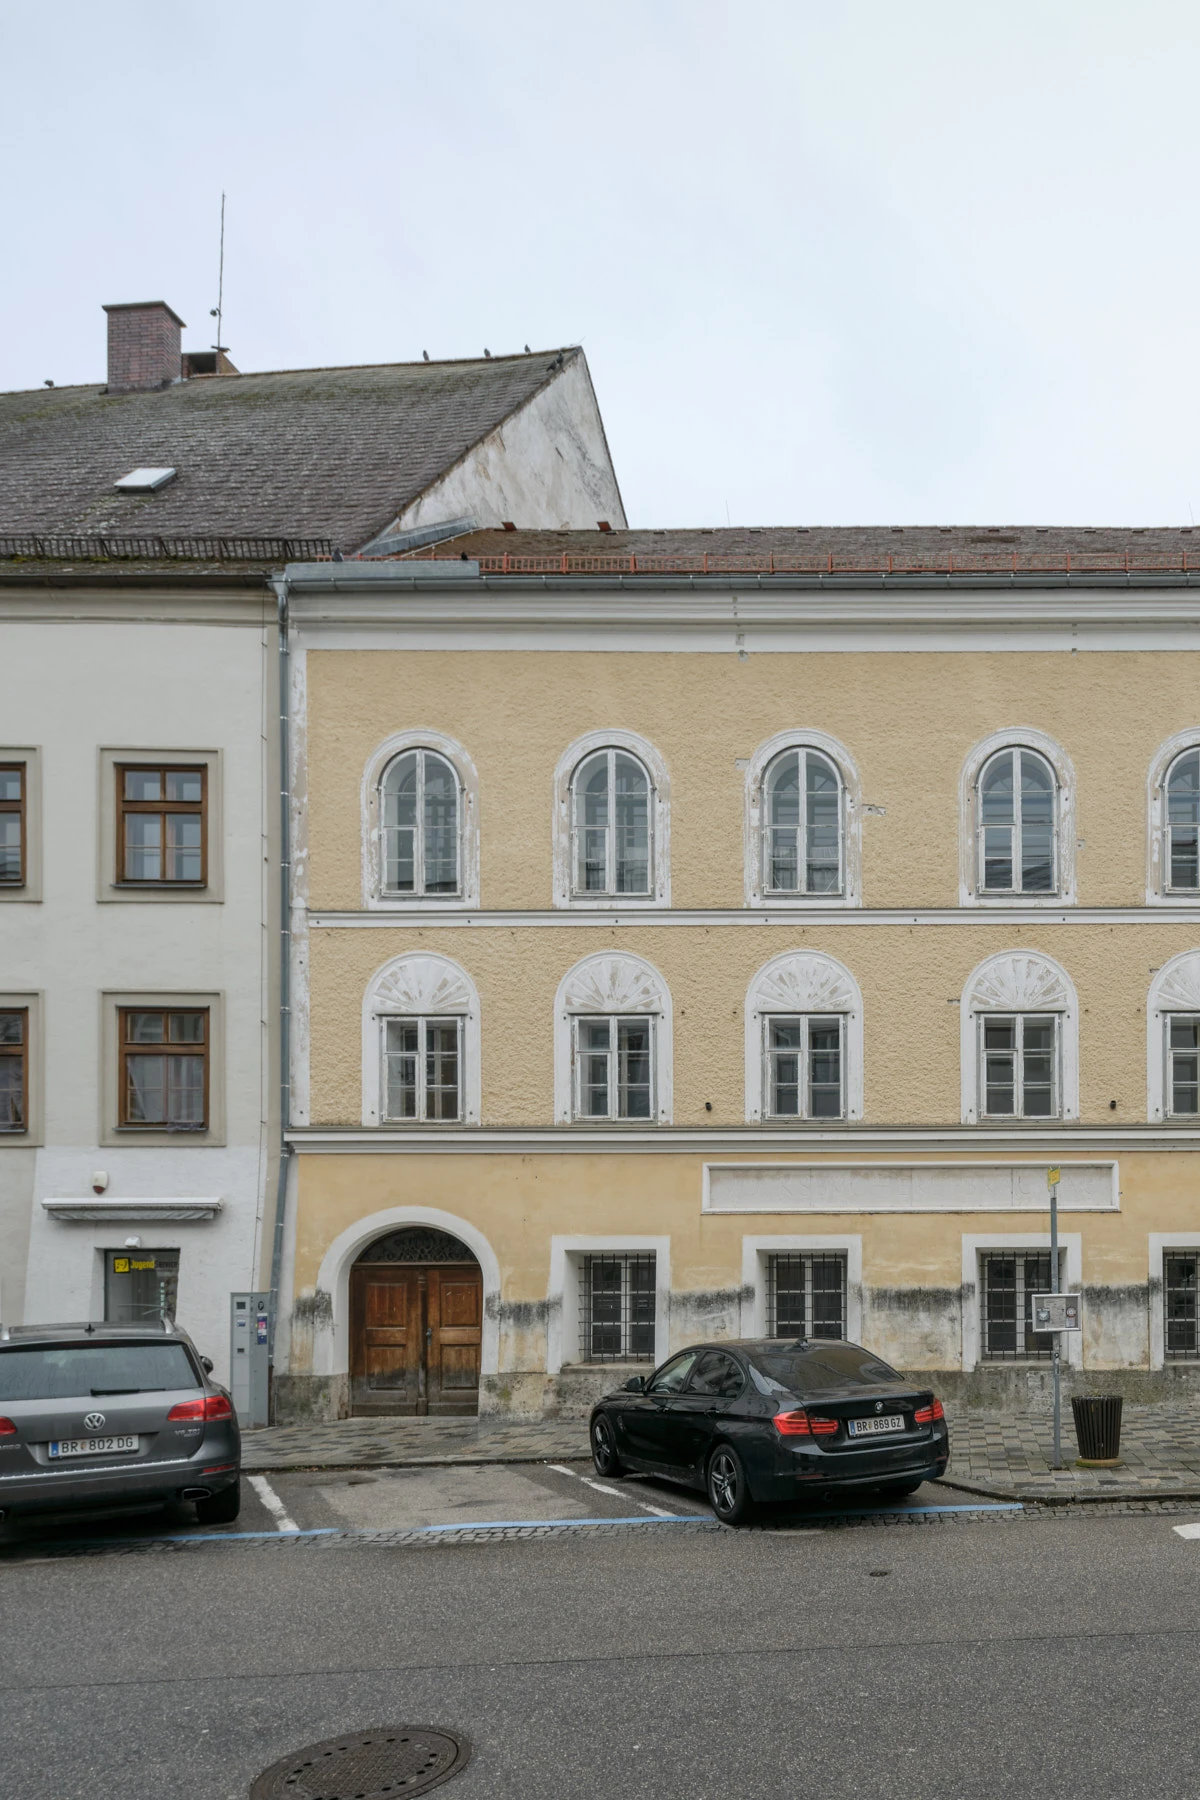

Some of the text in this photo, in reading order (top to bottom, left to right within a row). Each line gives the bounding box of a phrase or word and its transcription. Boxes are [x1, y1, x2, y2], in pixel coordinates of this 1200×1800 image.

[856, 1417, 902, 1432] BR 869 GZ
[61, 1436, 134, 1453] BR 802 DG
